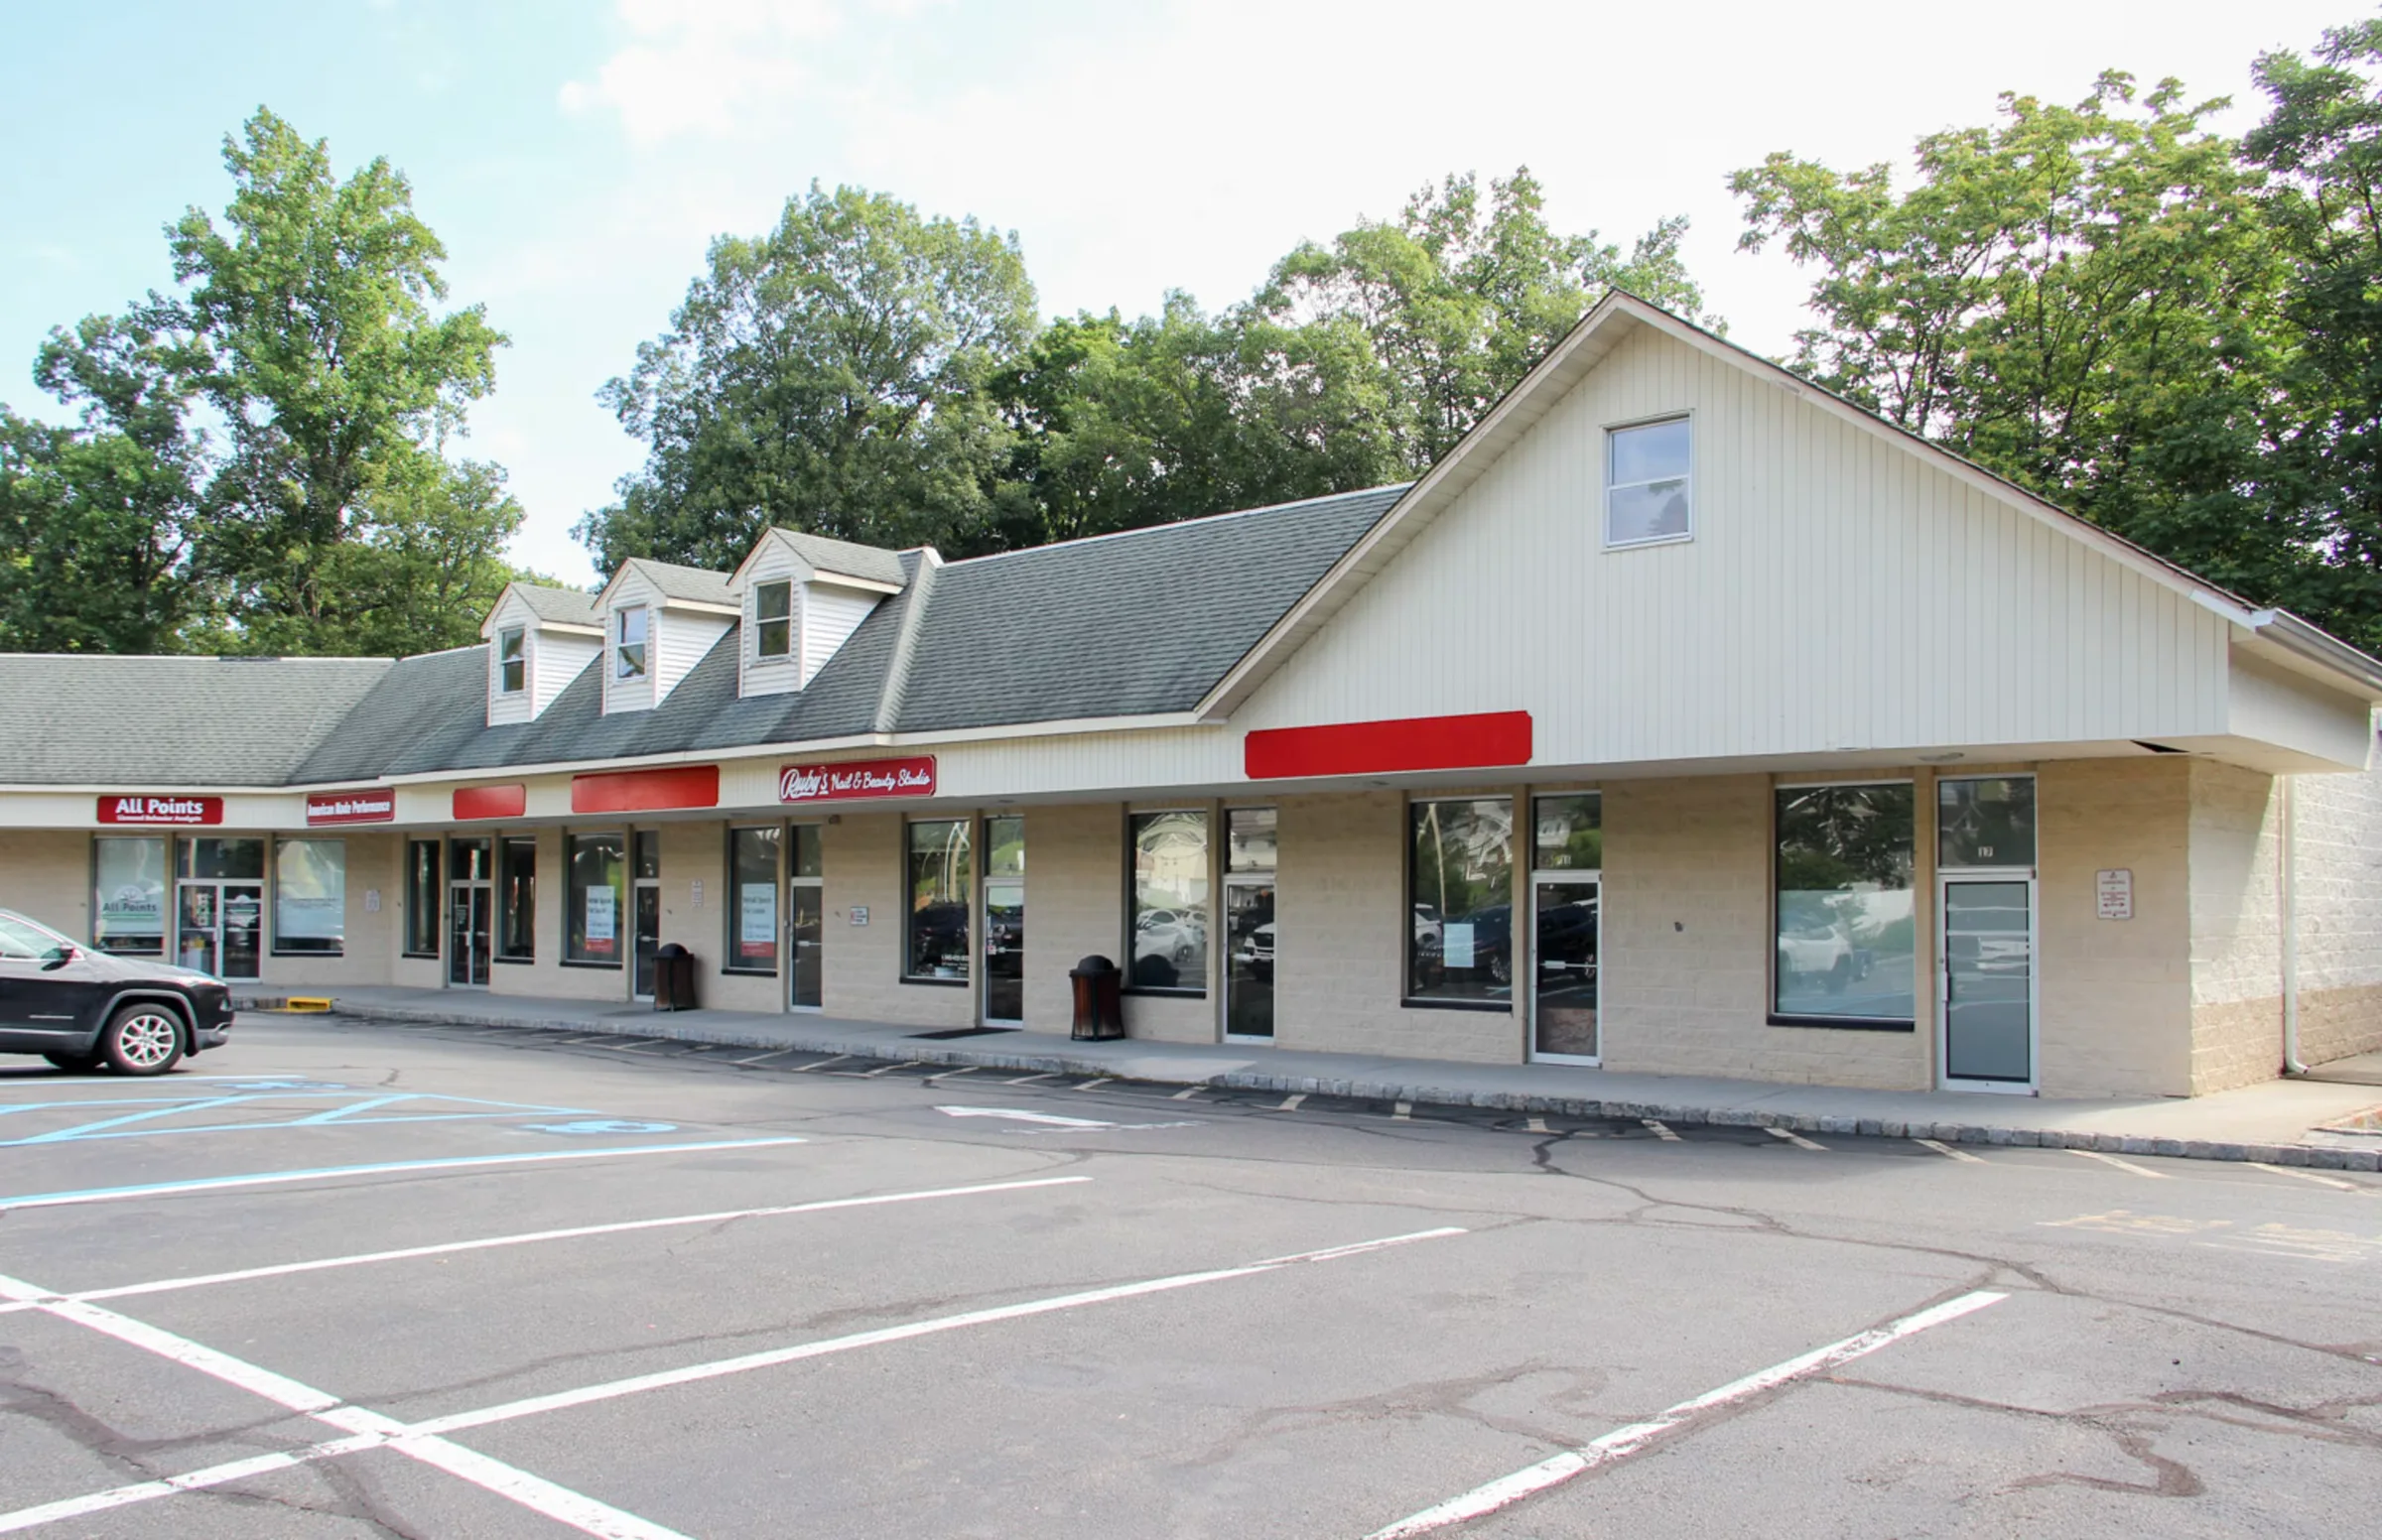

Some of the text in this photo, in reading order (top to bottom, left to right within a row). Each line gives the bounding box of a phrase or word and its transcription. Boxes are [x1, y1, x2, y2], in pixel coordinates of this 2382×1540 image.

[780, 768, 932, 800] Ruby's Nail & Beauty Studio
[115, 798, 203, 815] All Points
[103, 902, 157, 912] All Points
